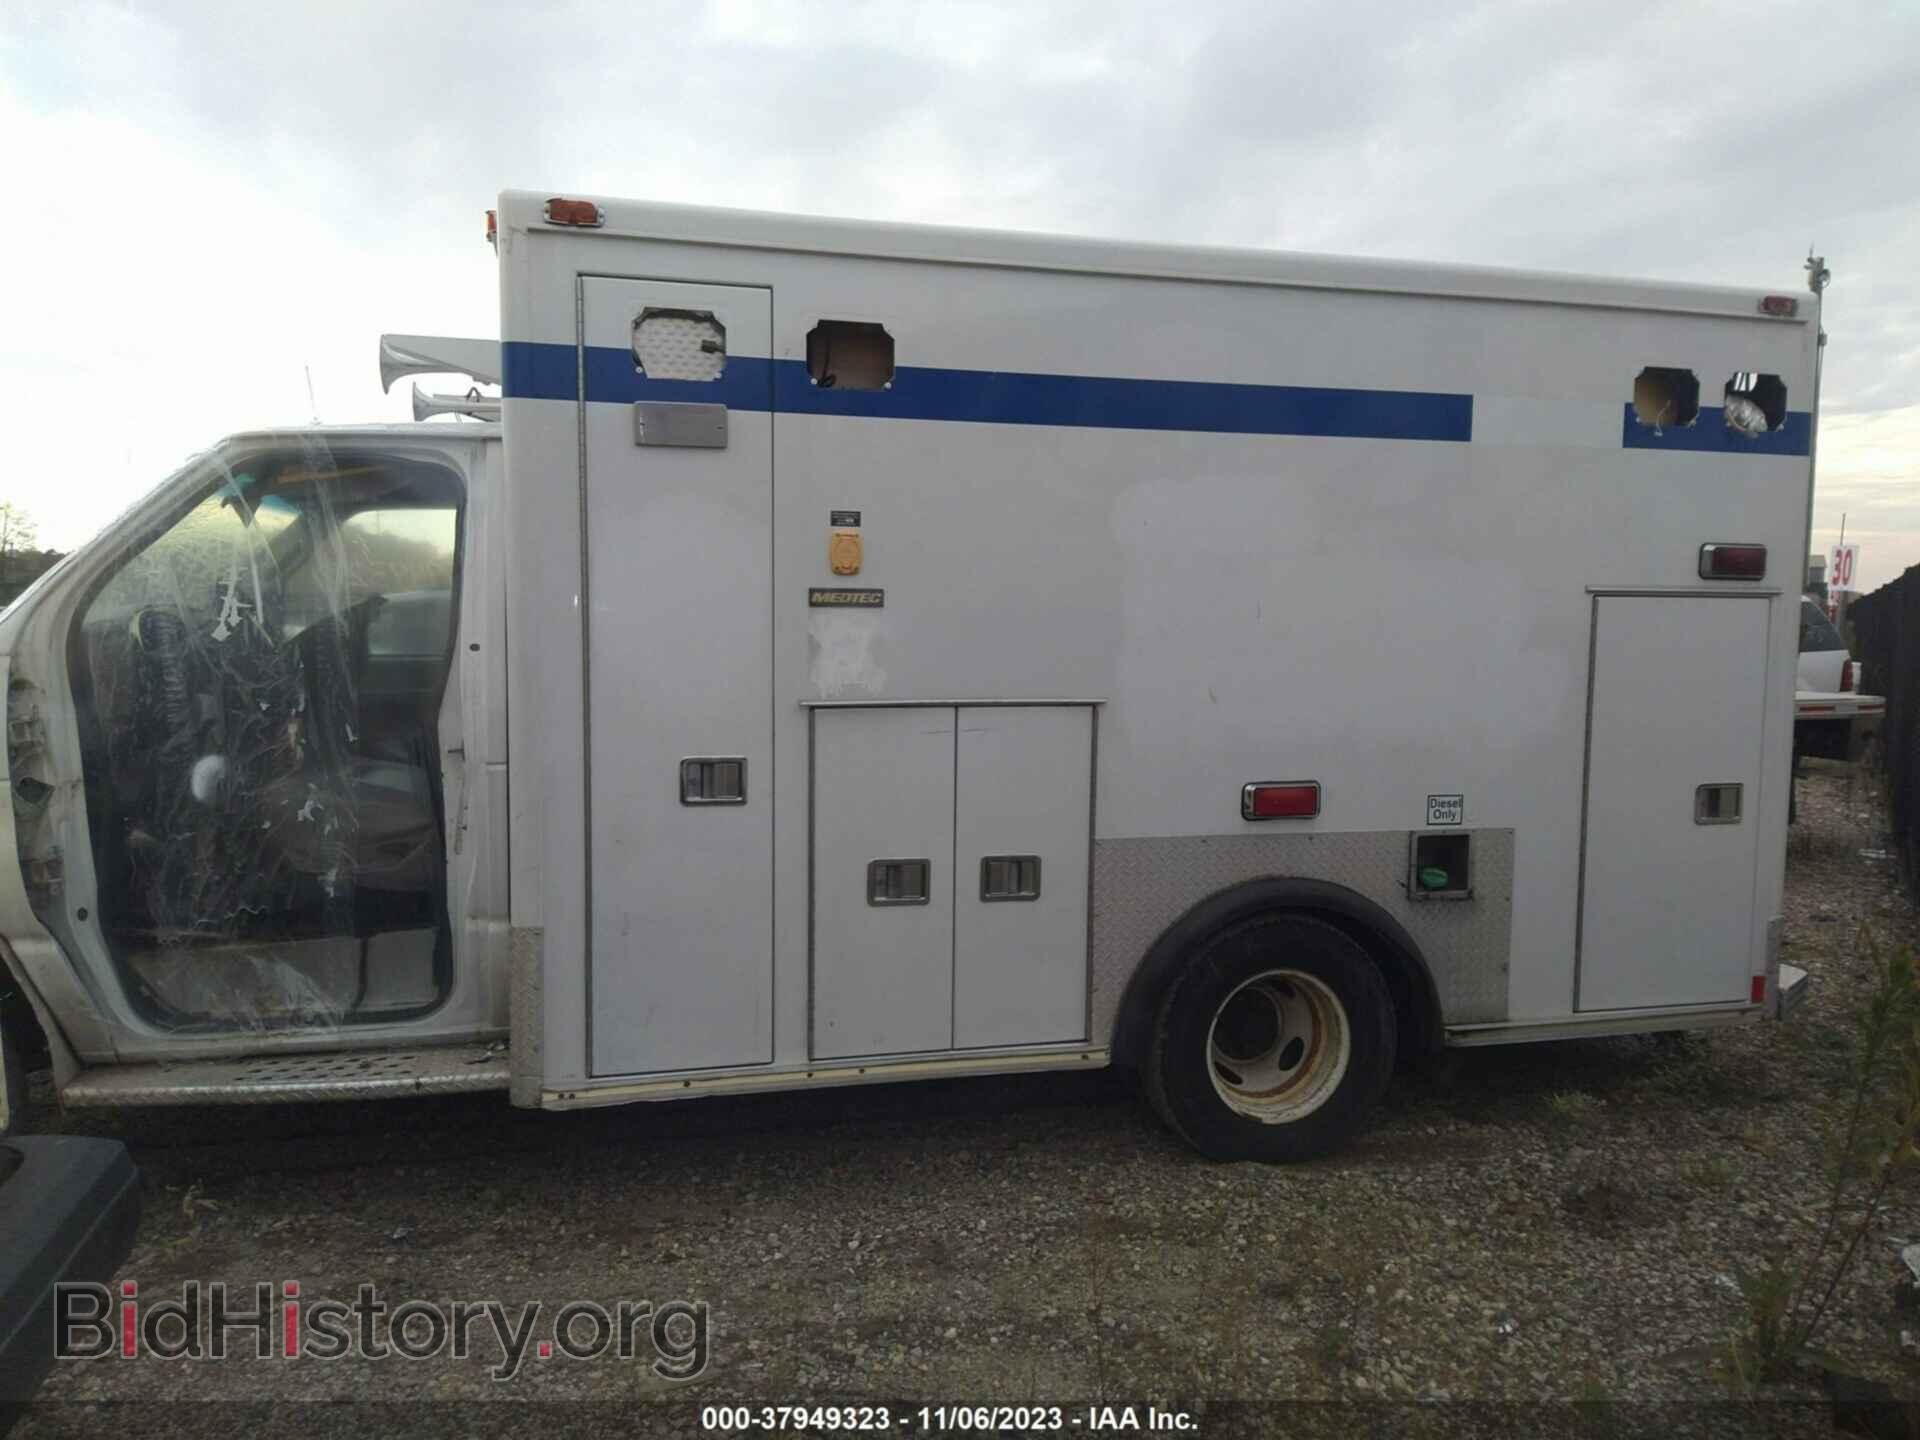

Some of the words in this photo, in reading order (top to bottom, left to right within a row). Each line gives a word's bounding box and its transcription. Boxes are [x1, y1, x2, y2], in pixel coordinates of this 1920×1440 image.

[1831, 548, 1853, 586] 30
[811, 591, 882, 603] MEDTEC
[1430, 798, 1462, 809] Diesel
[1433, 809, 1457, 821] Only
